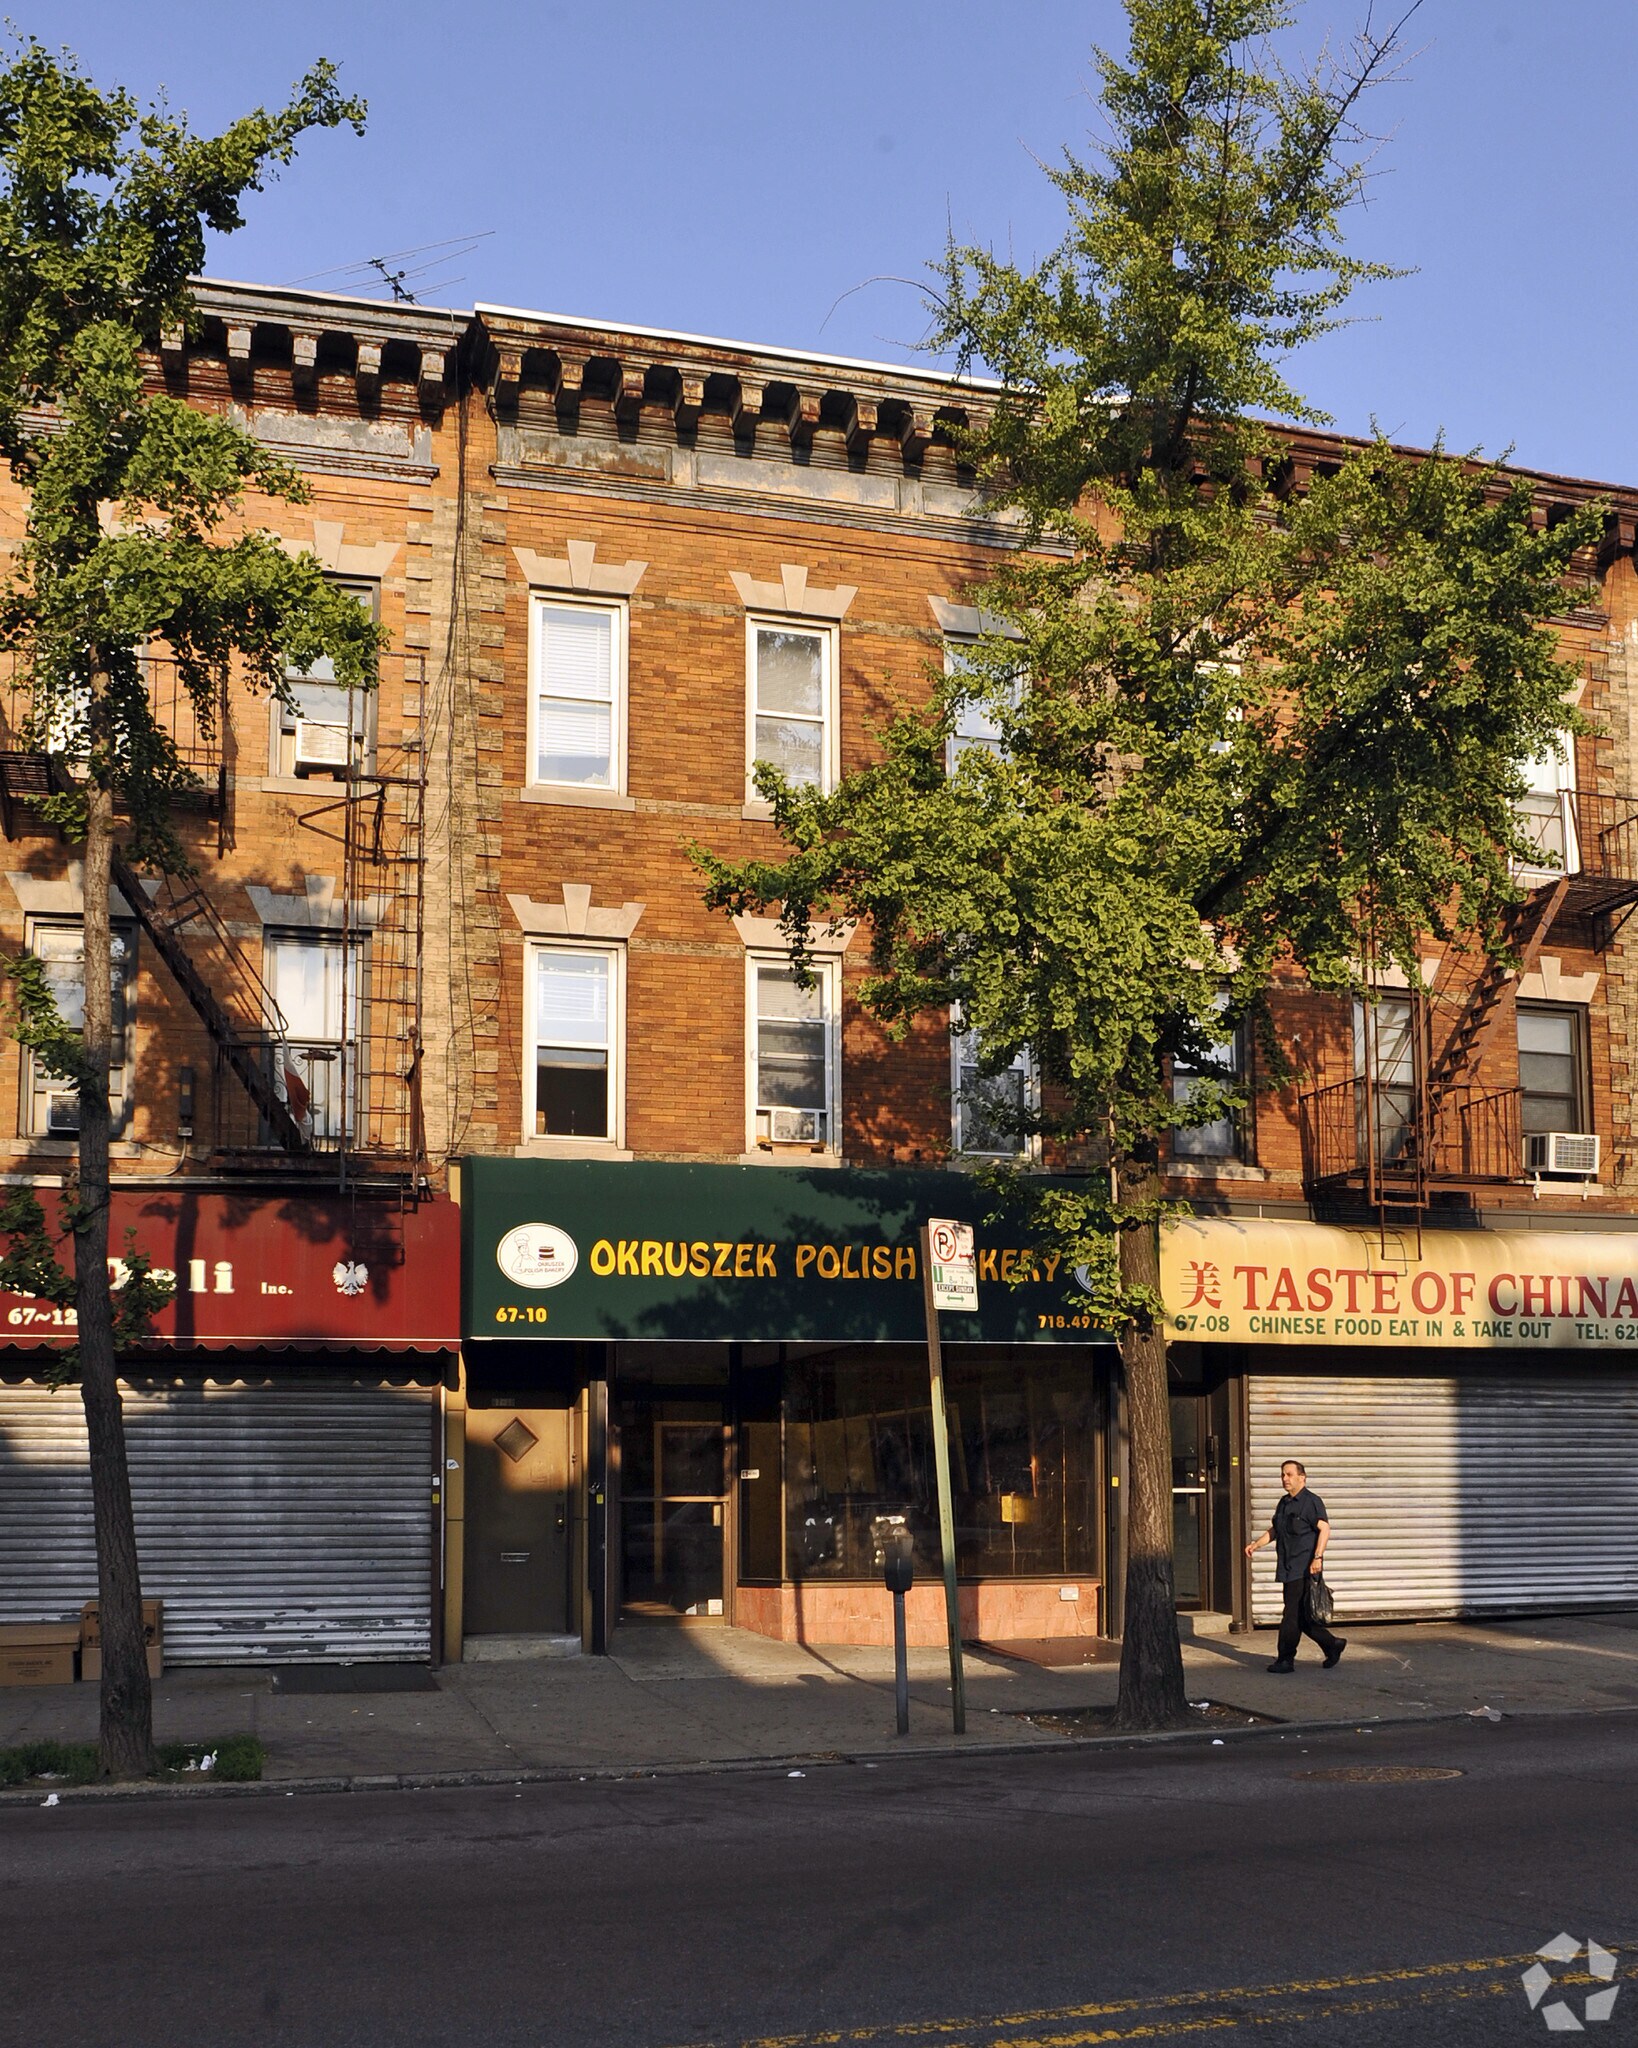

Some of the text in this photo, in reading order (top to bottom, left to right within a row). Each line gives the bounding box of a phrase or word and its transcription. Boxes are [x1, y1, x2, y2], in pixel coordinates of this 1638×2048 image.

[590, 1239, 1061, 1282] OKRUSZEK POLISH KERY
[261, 1281, 293, 1295] Inc.
[1180, 1260, 1222, 1309] 美
[1233, 1266, 1638, 1318] TASTE OF CHINA
[495, 1306, 547, 1323] 67-10
[1174, 1315, 1230, 1332] 67-08
[1249, 1316, 1326, 1335] CHINESE
[1335, 1319, 1382, 1336] FOOD
[1389, 1320, 1419, 1337] EAT
[1426, 1321, 1443, 1337] IN
[1453, 1321, 1466, 1337] &
[1472, 1321, 1513, 1338] TAKE
[1518, 1322, 1552, 1339] OUT
[1575, 1323, 1608, 1340] TEL:
